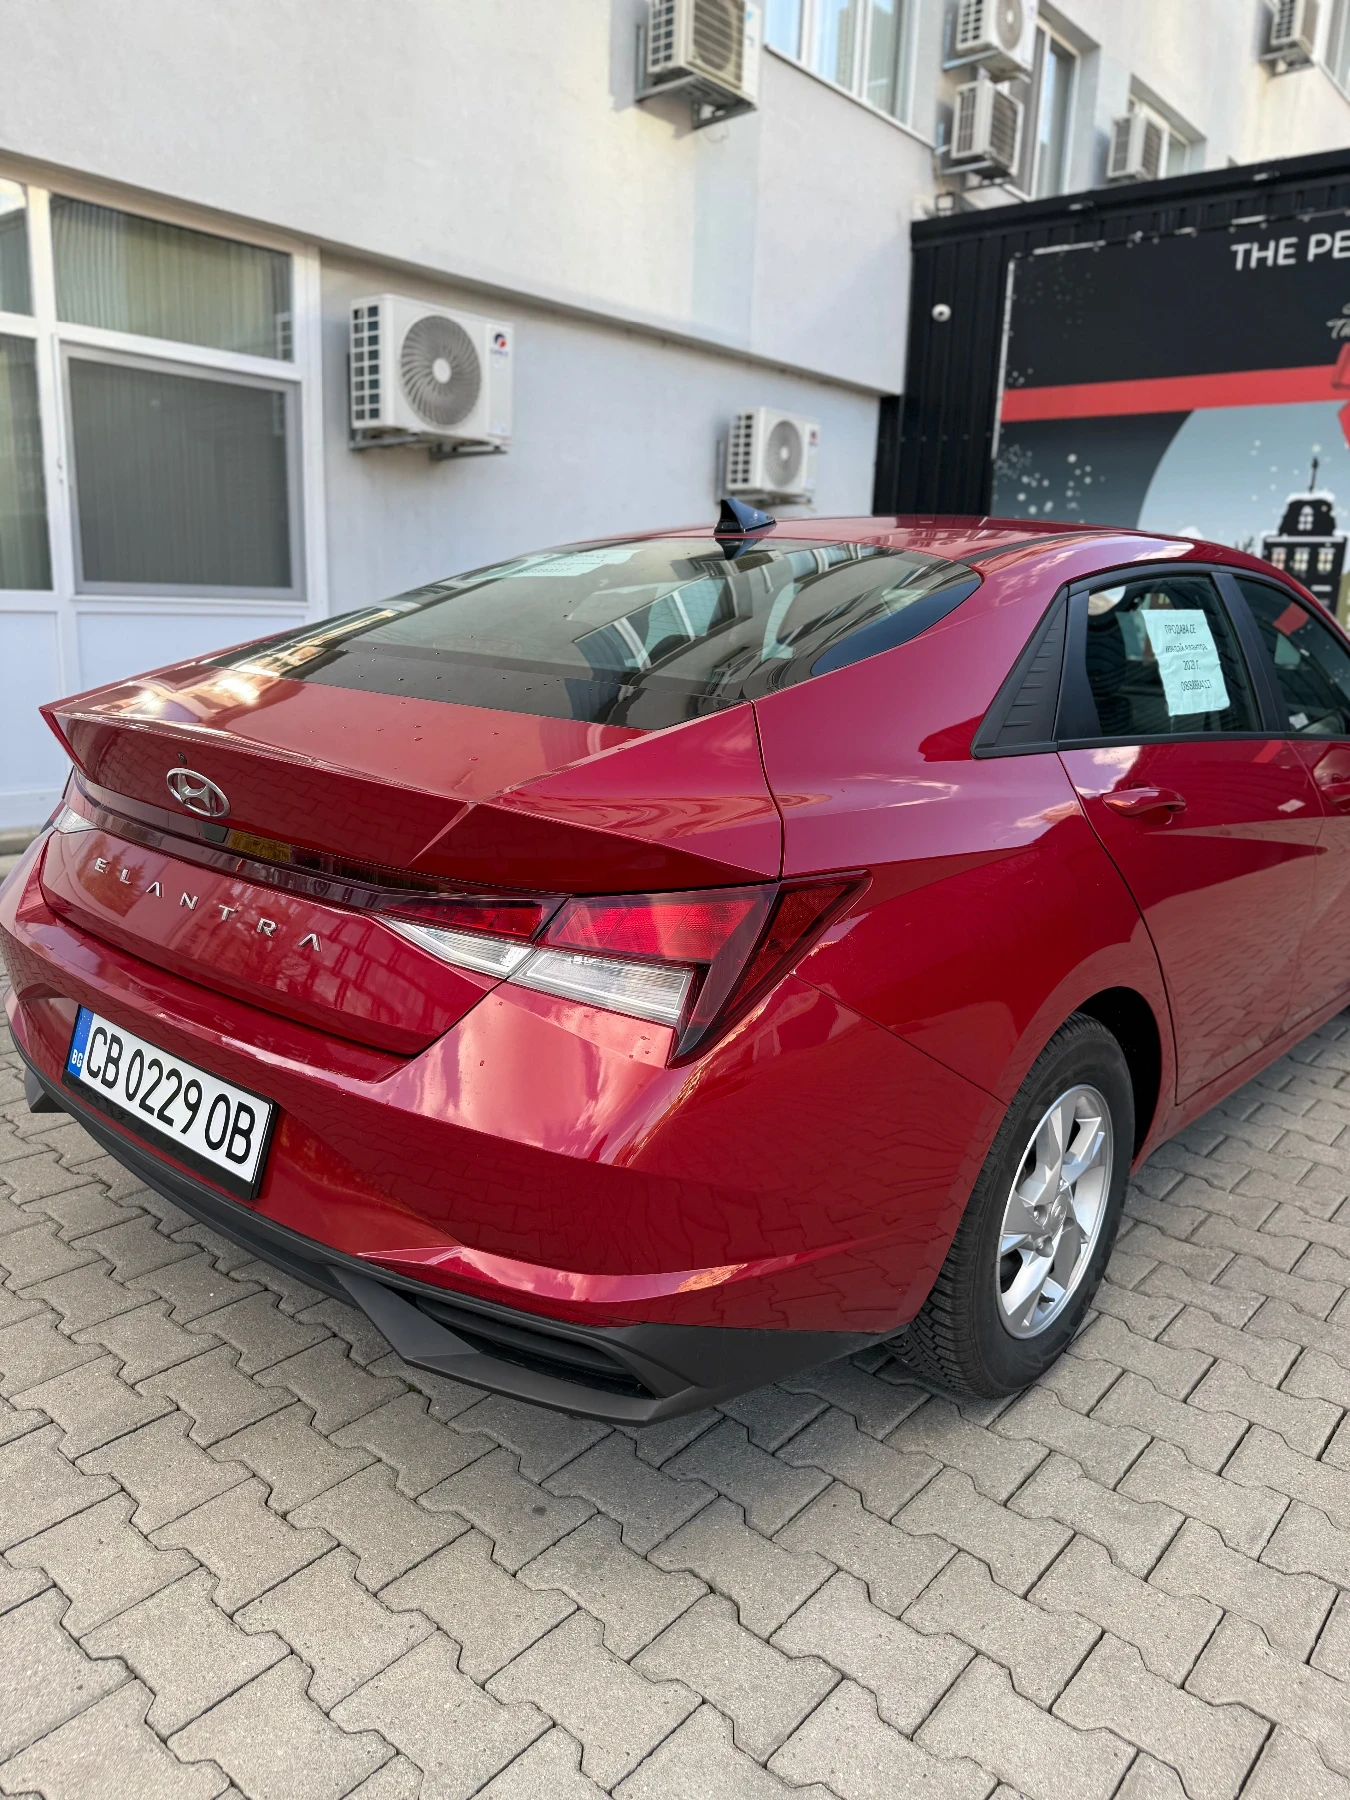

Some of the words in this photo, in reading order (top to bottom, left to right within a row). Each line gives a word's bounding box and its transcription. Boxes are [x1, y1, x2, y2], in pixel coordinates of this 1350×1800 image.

[1230, 236, 1298, 270] THE
[1164, 624, 1190, 635] ПРОДАВА
[94, 857, 322, 952] ELANTRA
[71, 1048, 83, 1068] BG
